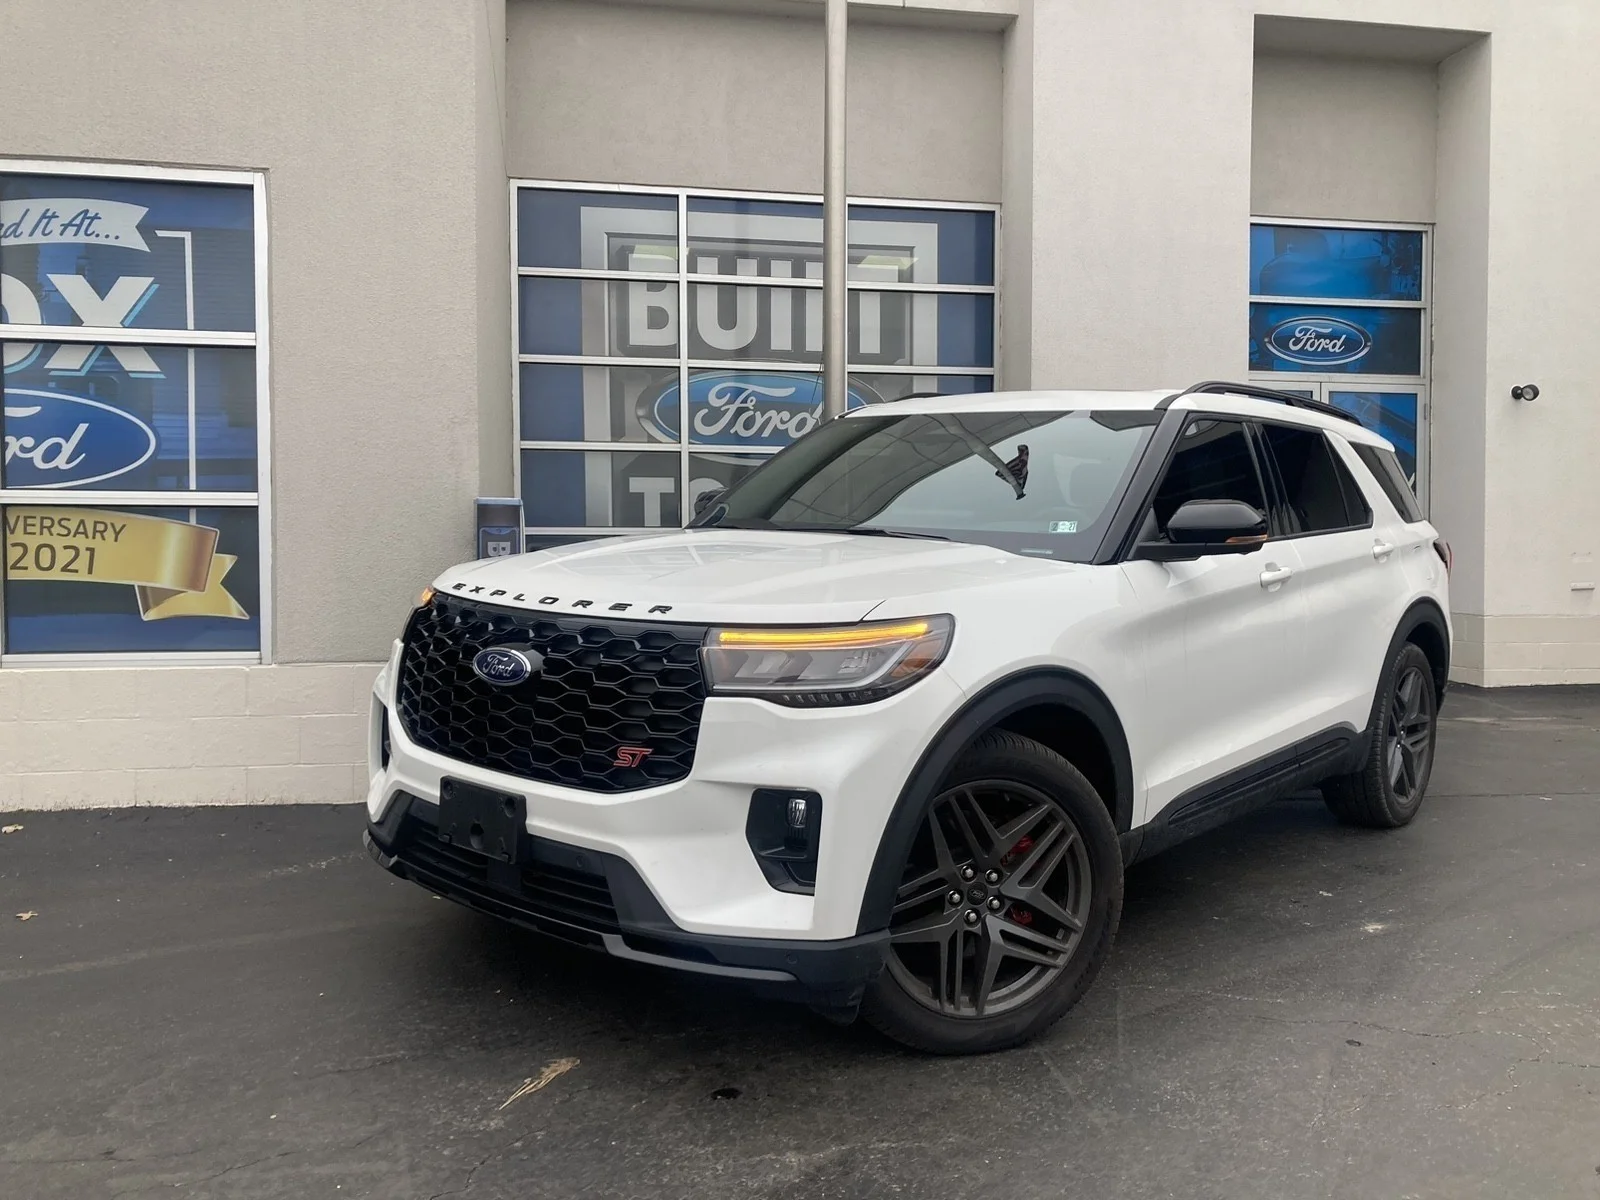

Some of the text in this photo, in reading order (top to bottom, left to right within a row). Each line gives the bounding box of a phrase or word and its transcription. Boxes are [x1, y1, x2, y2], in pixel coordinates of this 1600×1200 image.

[28, 208, 60, 237] It
[59, 208, 120, 240] At...
[1289, 325, 1347, 353] Ford
[9, 542, 97, 576] 2021
[452, 582, 673, 614] EXPLORER
[482, 653, 516, 677] Ford
[613, 746, 654, 768] ST
